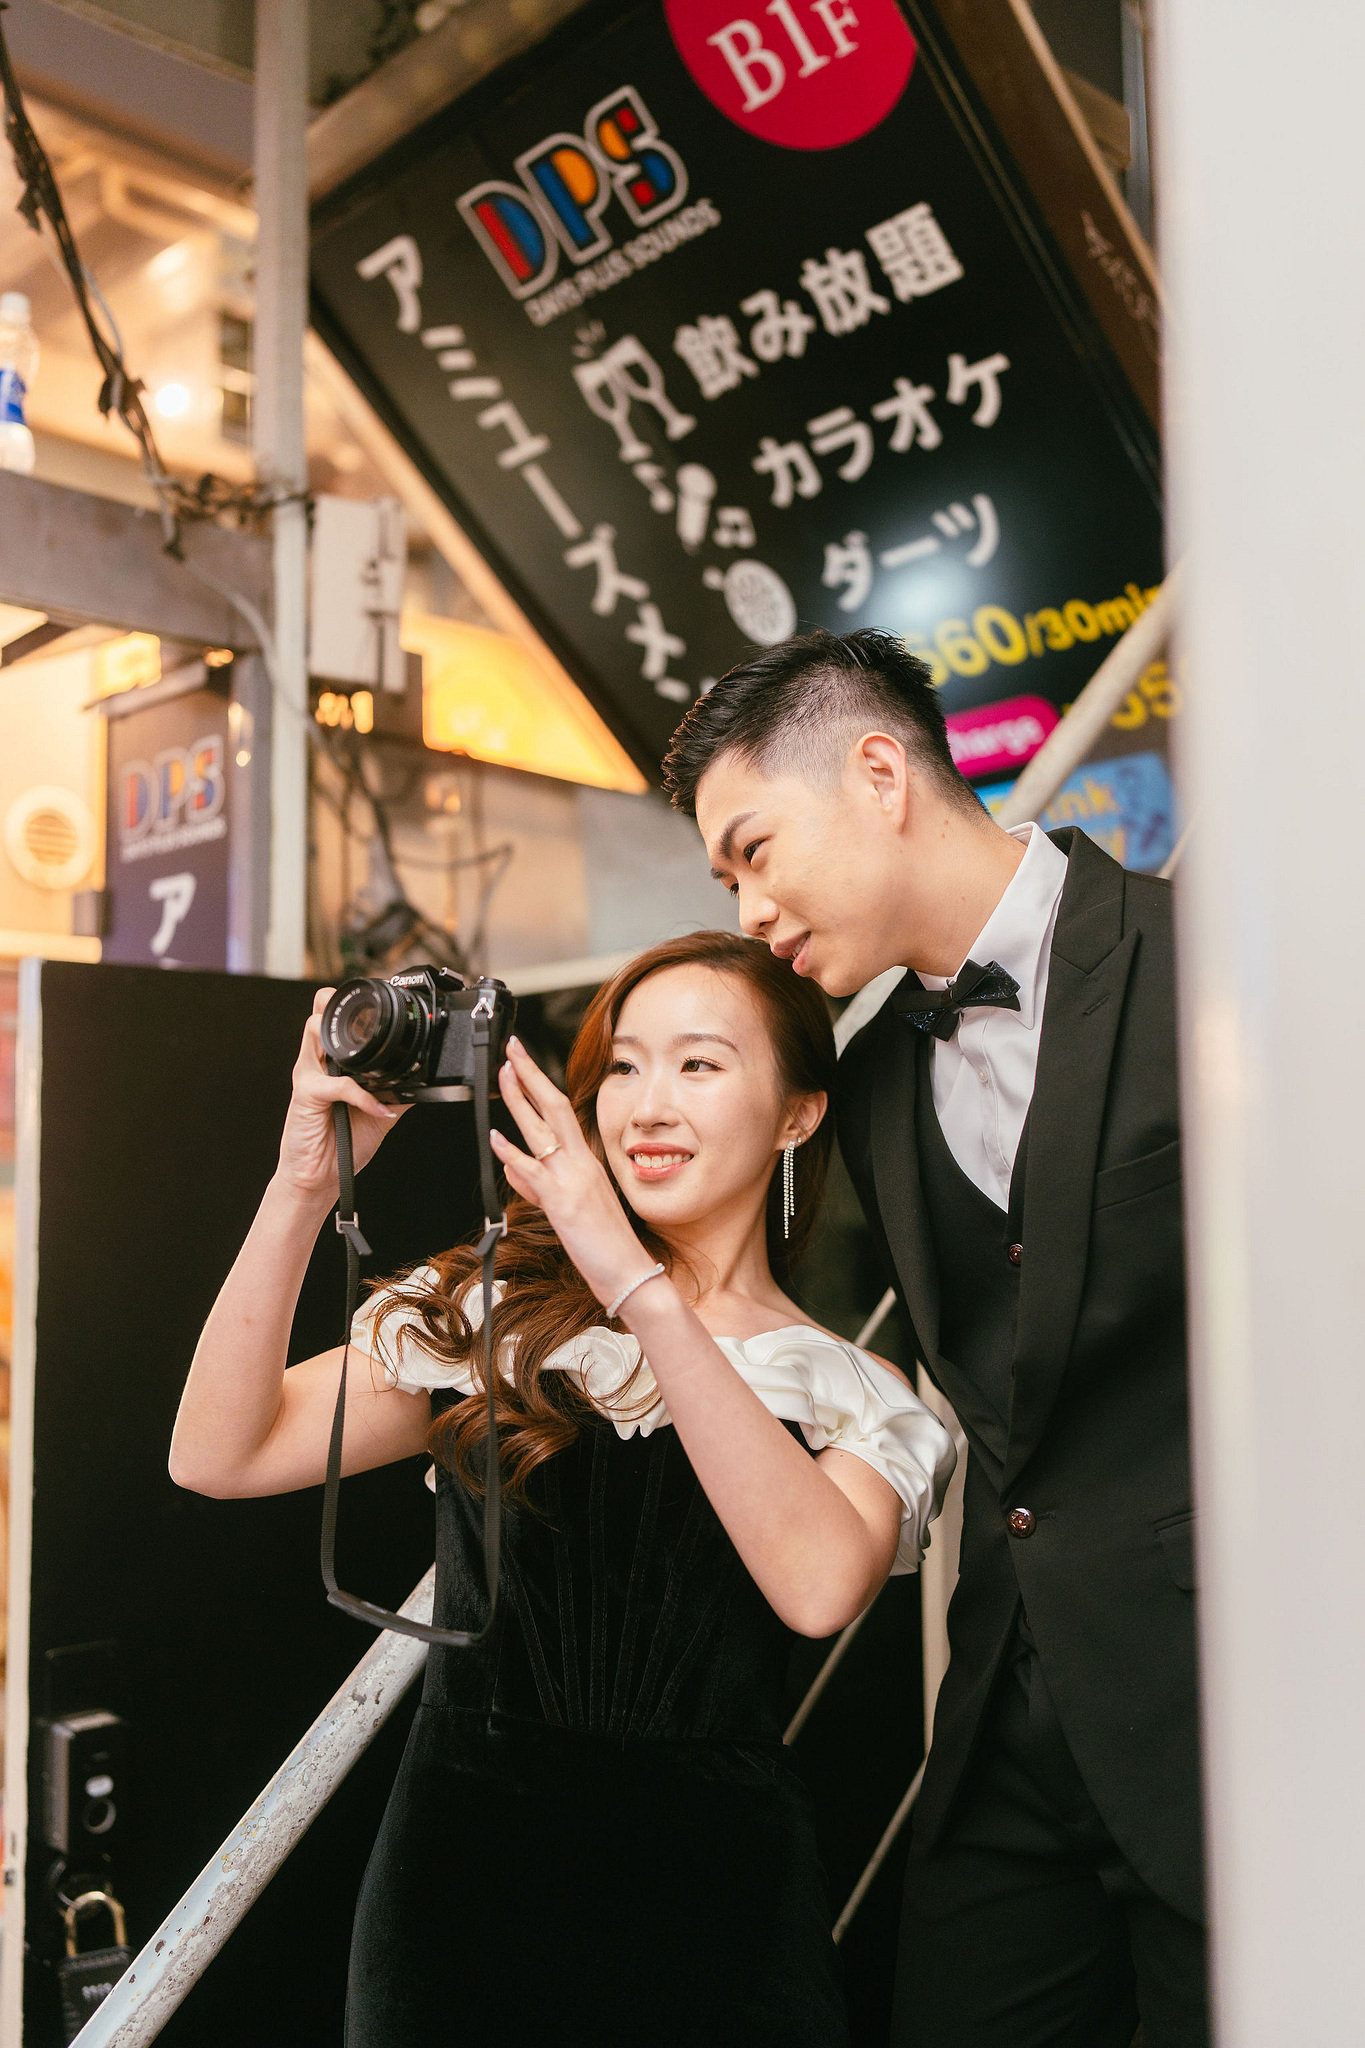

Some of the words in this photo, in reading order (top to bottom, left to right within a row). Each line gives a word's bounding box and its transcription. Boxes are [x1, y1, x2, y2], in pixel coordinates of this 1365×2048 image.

[706, 0, 859, 113] B1F
[456, 85, 689, 300] DPS
[622, 198, 723, 271] SOUNDS
[674, 202, 965, 400] 飲み放題
[753, 353, 1010, 509] カラオケ
[823, 494, 999, 613] ダーツ
[120, 734, 227, 838] DPS
[150, 872, 196, 970] ア
[390, 974, 424, 987] Canon
